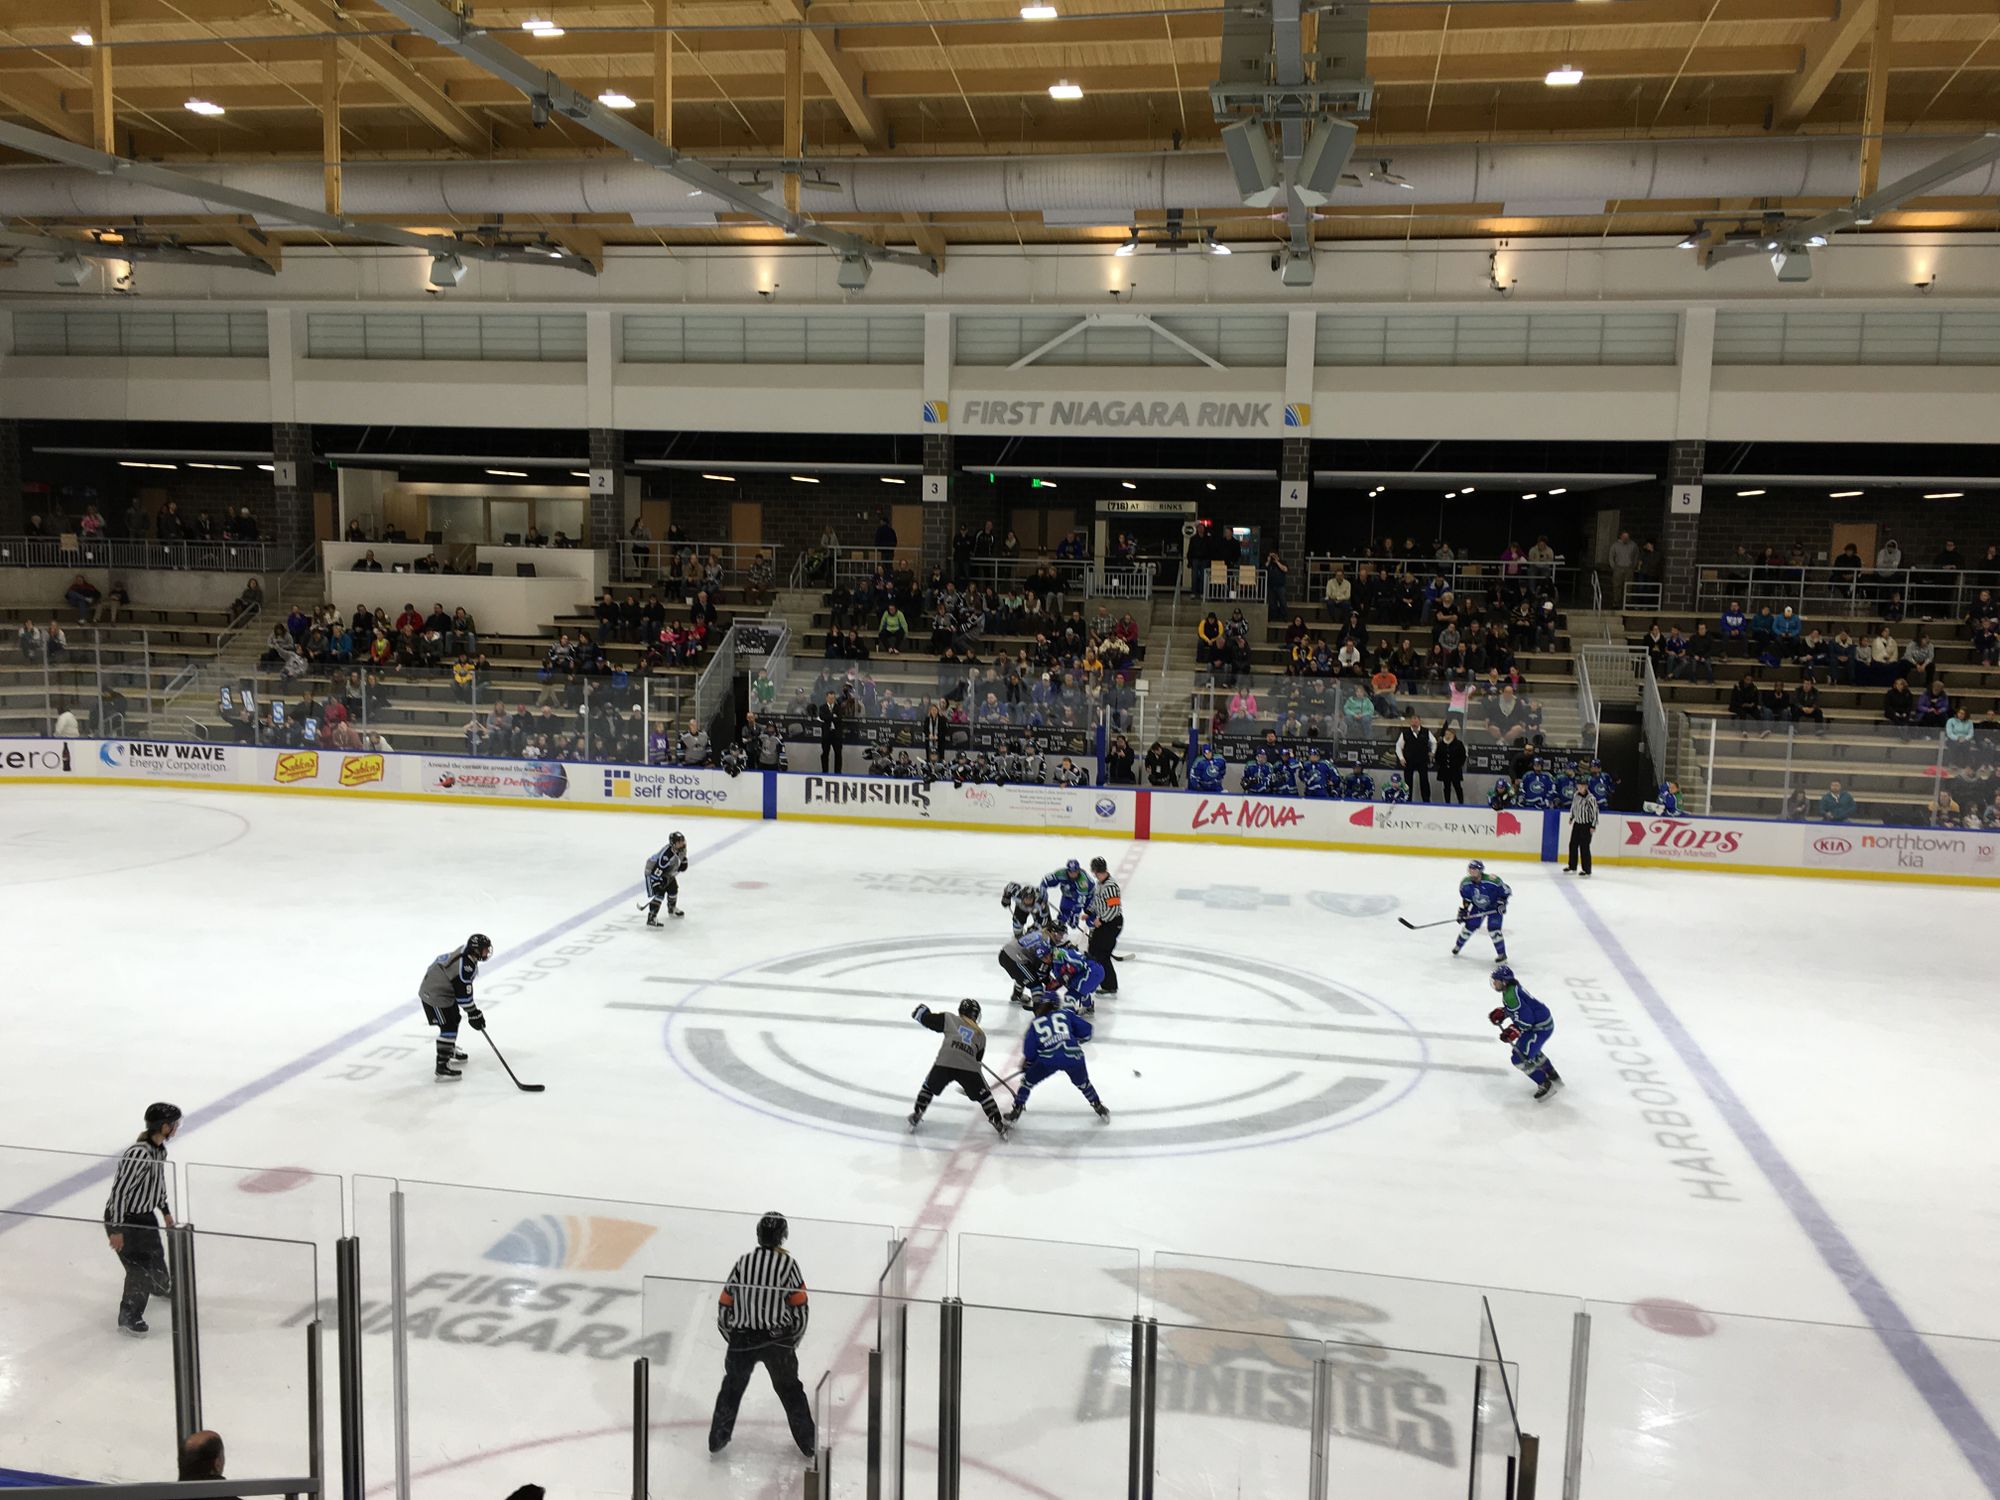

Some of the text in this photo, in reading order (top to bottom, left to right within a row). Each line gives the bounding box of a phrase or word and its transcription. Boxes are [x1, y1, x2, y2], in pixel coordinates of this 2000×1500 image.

[962, 401, 1273, 428] FIRST NIAGARA RINK
[281, 467, 288, 481] 1
[597, 475, 605, 488] 2
[931, 483, 939, 495] 3
[1290, 488, 1298, 501] 4
[1159, 503, 1183, 511] RINKS
[1682, 493, 1690, 505] 5
[0, 751, 60, 769] ero
[129, 743, 225, 761] NEW WAVE
[129, 758, 227, 773] Energy Corporation
[456, 775, 500, 785] SPEED
[634, 773, 700, 785] Uncle Bob's
[635, 785, 727, 804] self storage
[805, 776, 931, 814] CANISIUS
[1192, 799, 1305, 829] LA NOVA
[1386, 819, 1496, 835] SAINT FRANCIS
[1820, 840, 1846, 851] KIA
[1861, 833, 1966, 853] northtown
[1898, 850, 1924, 868] kia
[853, 871, 1008, 889] SENEC
[1032, 1012, 1070, 1043] 56
[1564, 976, 1743, 1203] HARBORCENTER
[406, 1271, 643, 1316] FIRST
[279, 1297, 673, 1366] NIAGARA
